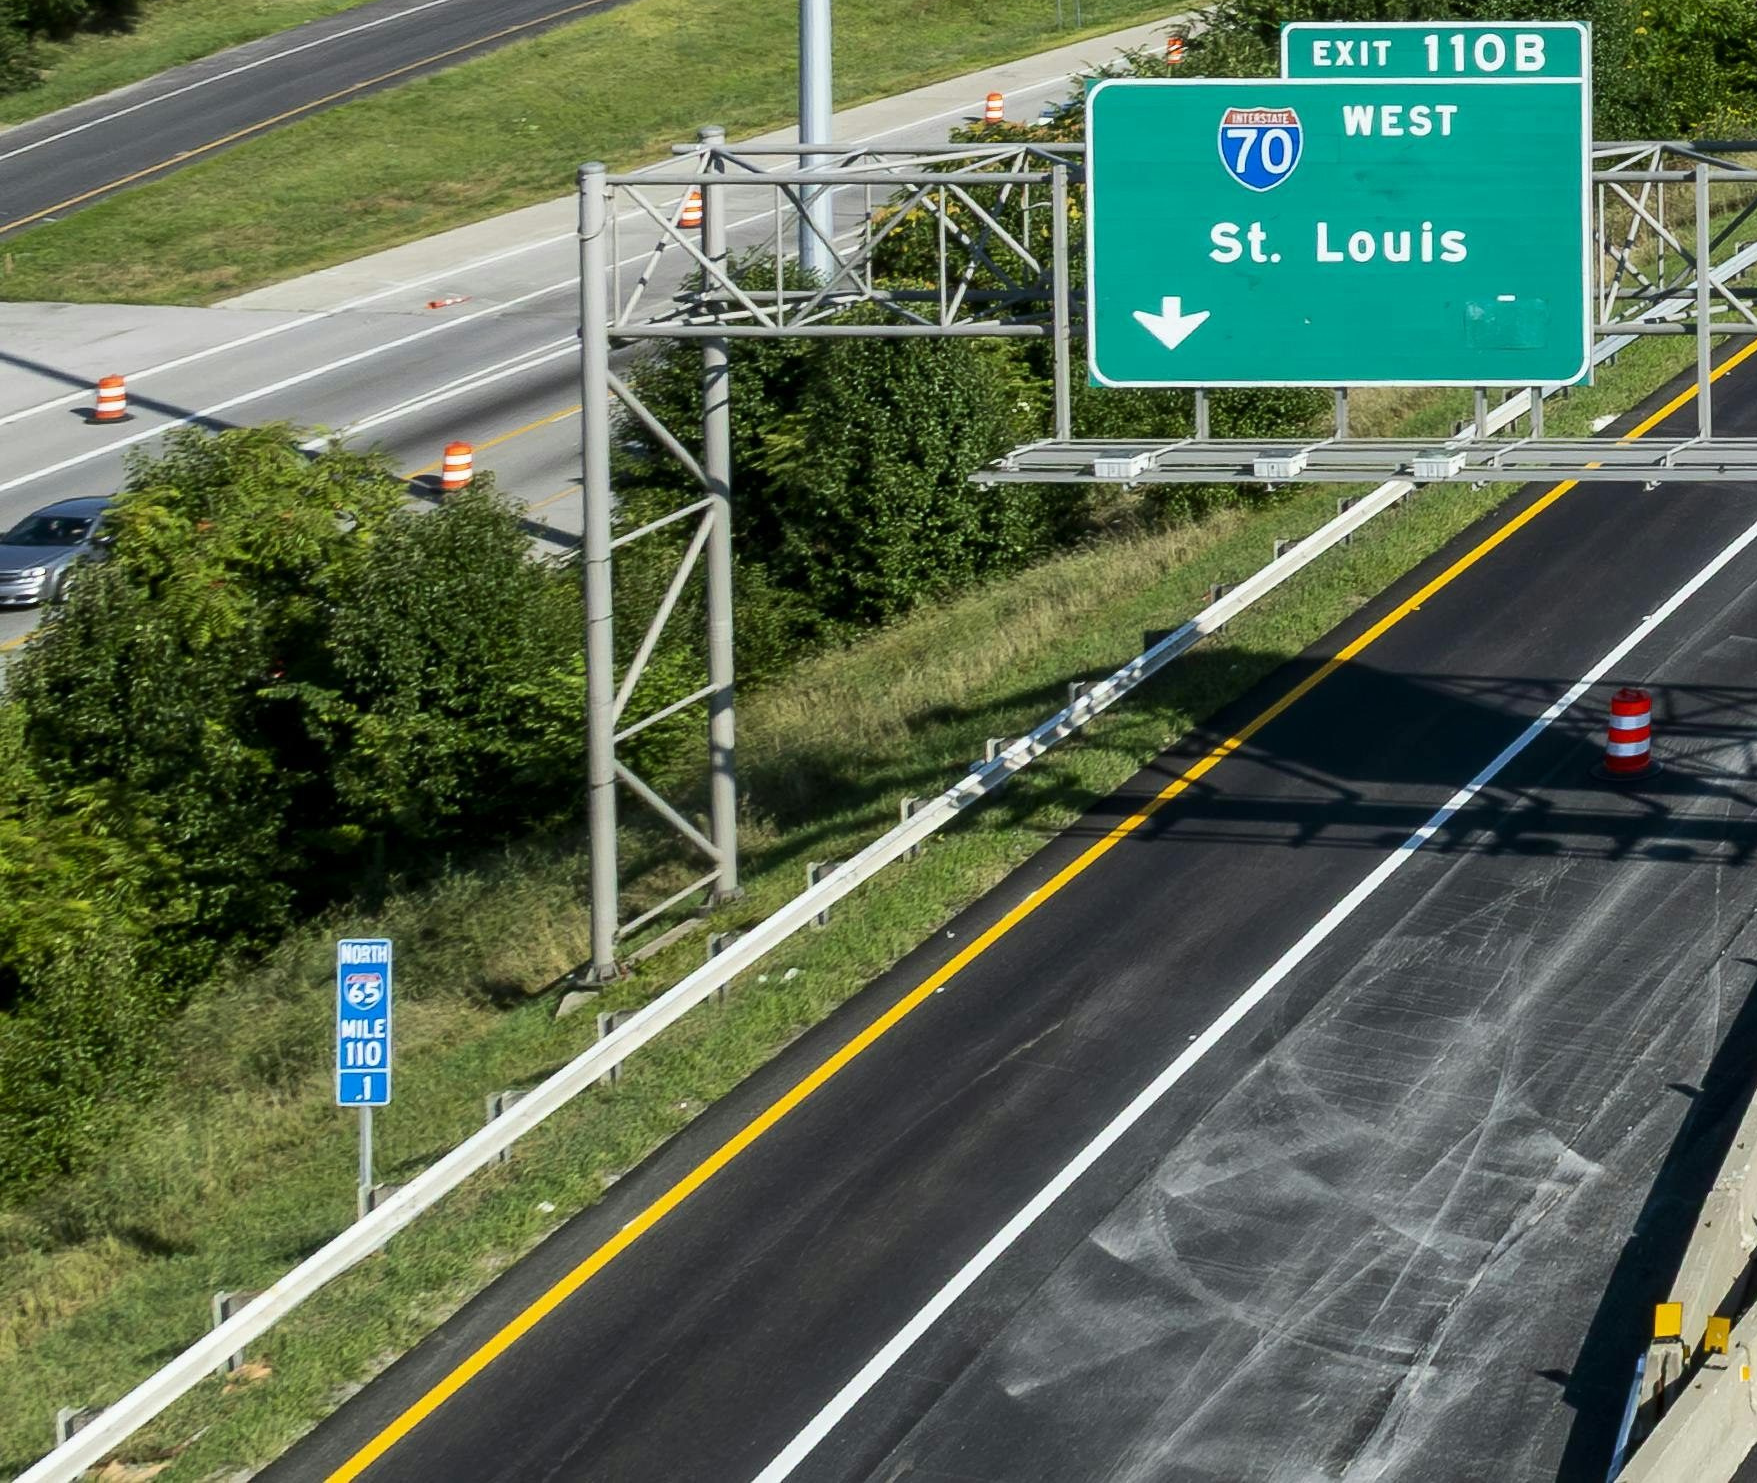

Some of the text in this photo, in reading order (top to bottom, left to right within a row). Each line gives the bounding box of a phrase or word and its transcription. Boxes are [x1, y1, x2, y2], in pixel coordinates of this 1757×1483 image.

[1313, 34, 1546, 73] EXIT 110B
[1231, 112, 1290, 124] INTERSTATE
[1342, 104, 1458, 137] WEST
[1227, 128, 1293, 175] 70
[1209, 221, 1468, 264] St. Louis
[341, 944, 388, 964] NORTH
[348, 981, 380, 1004] 65
[341, 1018, 386, 1039] MILE
[346, 1041, 382, 1067] 110
[355, 1076, 372, 1101] .1
